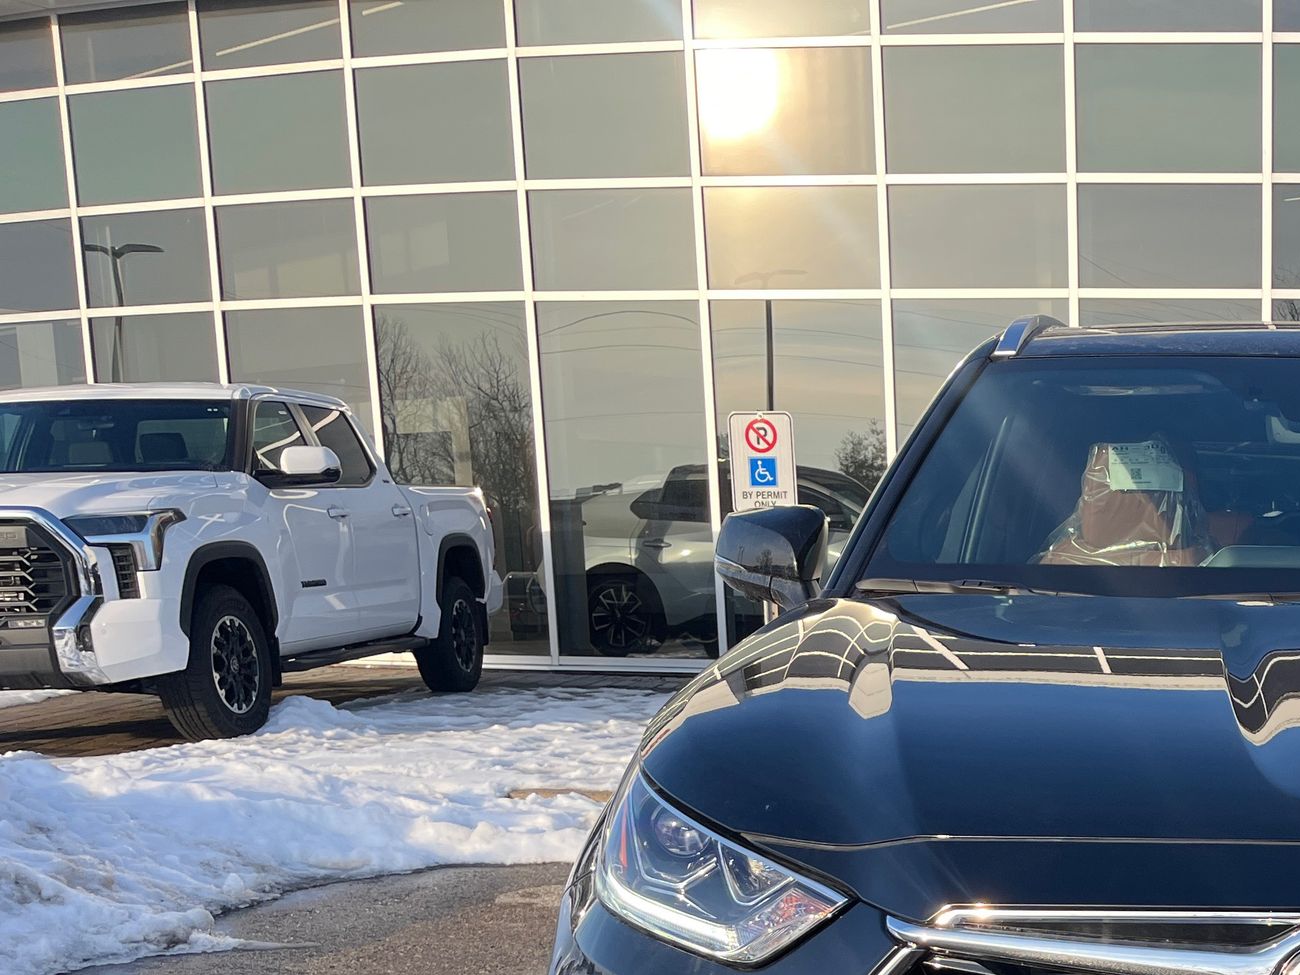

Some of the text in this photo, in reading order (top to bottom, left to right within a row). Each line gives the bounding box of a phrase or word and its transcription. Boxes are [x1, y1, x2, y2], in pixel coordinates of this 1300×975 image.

[756, 427, 767, 445] P
[742, 491, 788, 499] BY PERMIT
